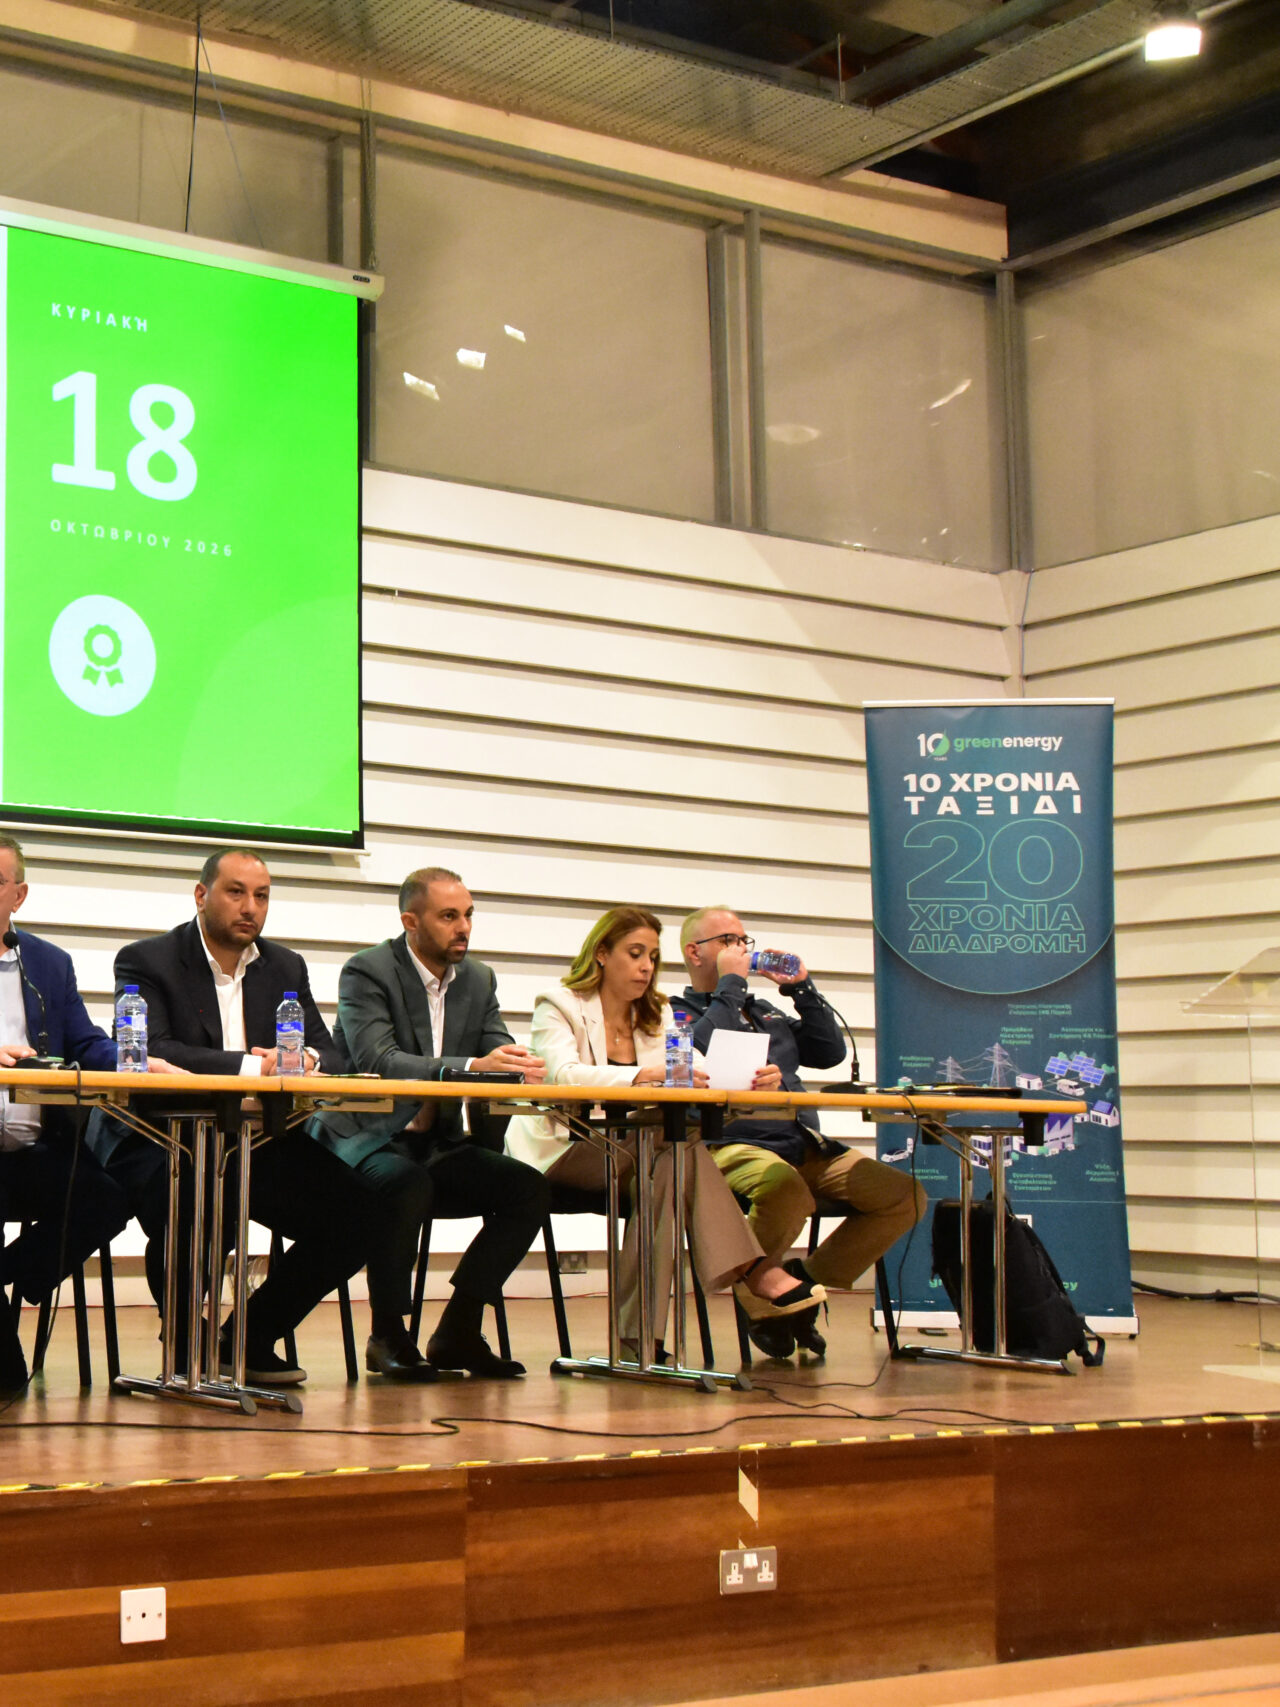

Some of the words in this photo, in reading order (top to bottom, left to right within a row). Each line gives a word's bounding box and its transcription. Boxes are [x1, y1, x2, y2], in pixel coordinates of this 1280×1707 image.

[51, 370, 198, 502] 18
[50, 519, 171, 548] ΟΚΤΩΒΡΙΟΥ
[184, 539, 232, 557] 2026
[917, 732, 950, 757] 10
[954, 736, 1063, 752] greenenergy
[904, 773, 941, 793] 10
[949, 771, 1080, 793] ΧΡΟΝΙΑ
[904, 795, 1081, 815] ΤΑΞΙΔΙ
[903, 818, 1083, 901] 20
[908, 903, 1085, 931] ΧΡΟΝΙΑ
[908, 933, 1086, 953] ΔΙΑΔΡΟΜΗ
